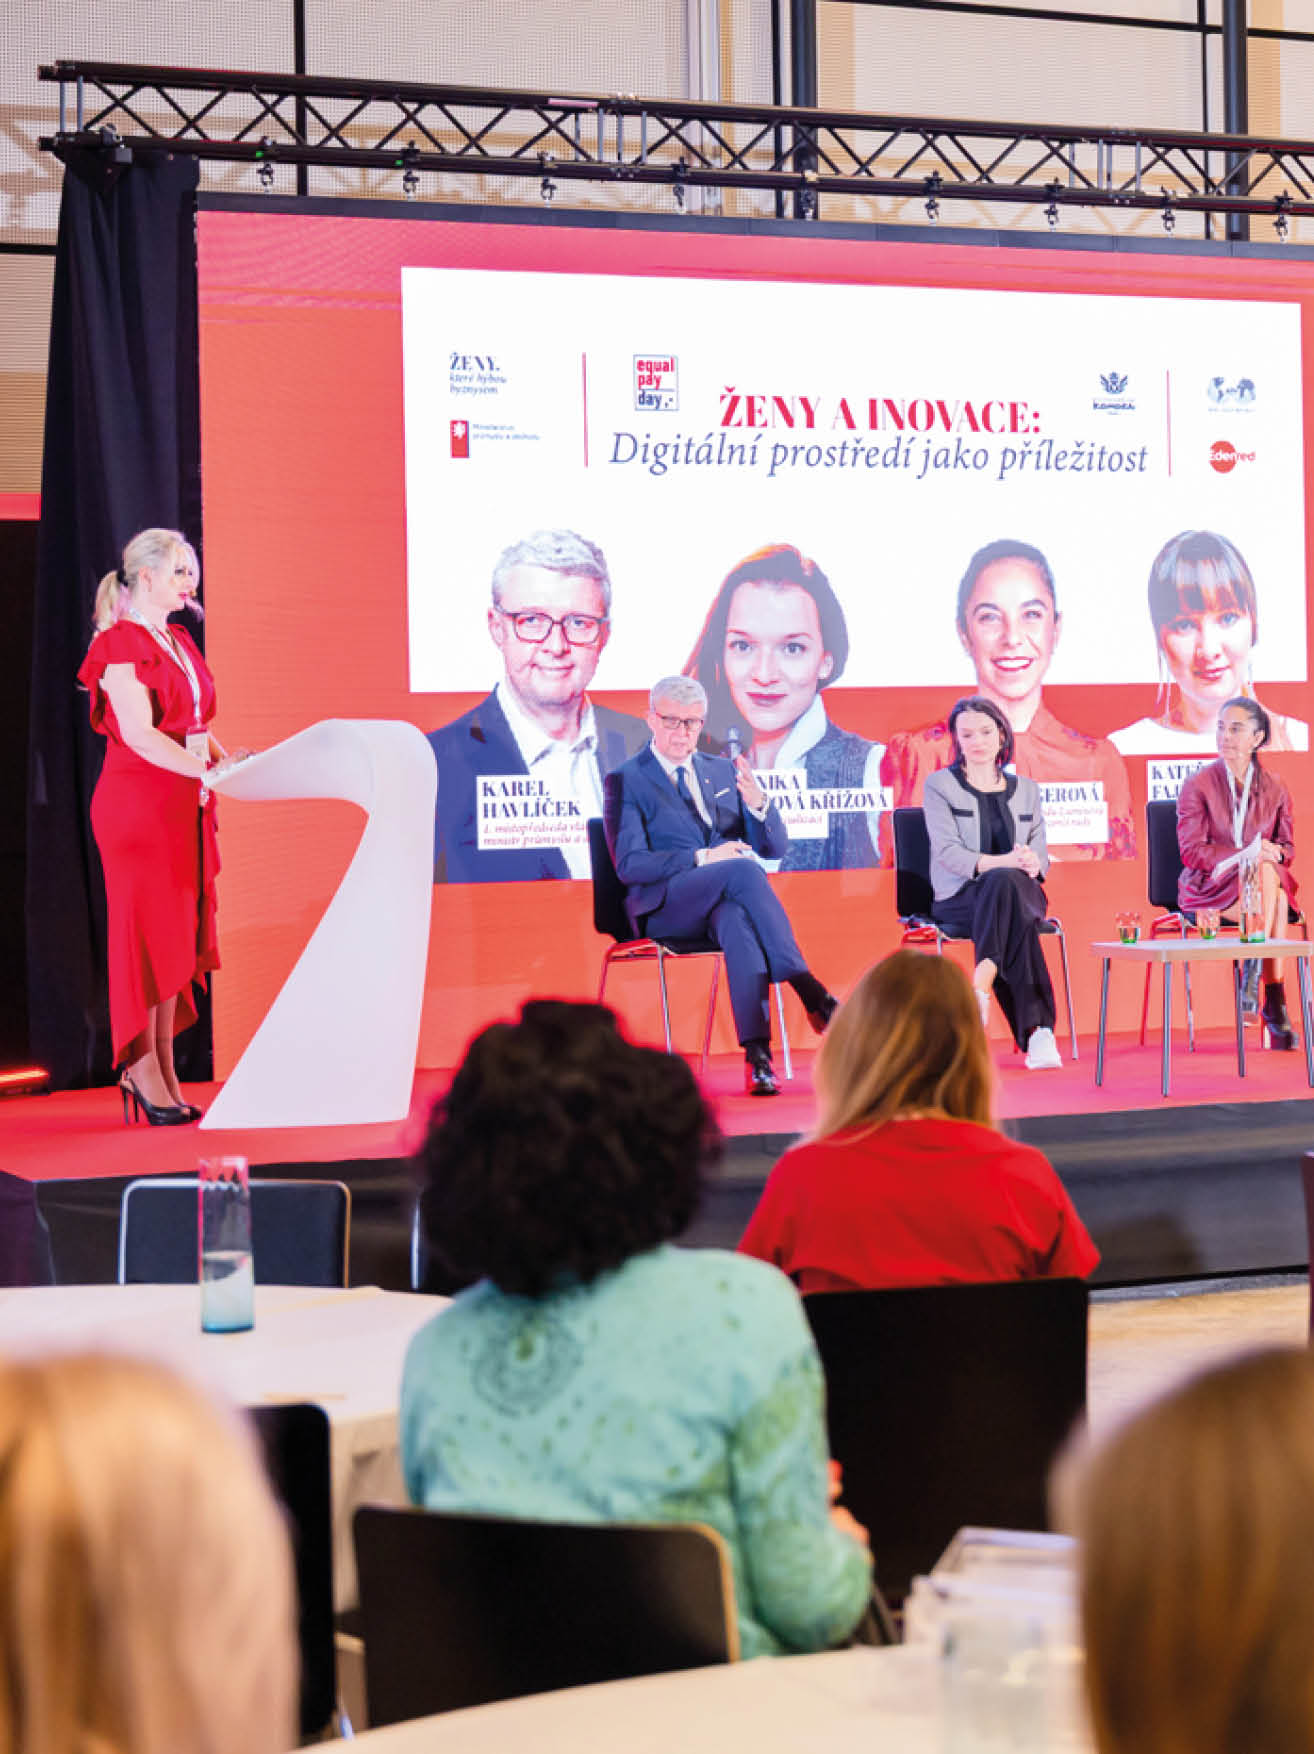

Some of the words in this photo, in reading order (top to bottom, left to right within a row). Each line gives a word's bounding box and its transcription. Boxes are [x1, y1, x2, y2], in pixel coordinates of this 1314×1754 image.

[637, 356, 675, 376] equal
[638, 375, 662, 391] pay
[720, 385, 821, 429] ŽENY
[831, 397, 857, 431] A
[868, 396, 1041, 434] INOVACE:
[608, 432, 763, 476] Digitální
[766, 435, 916, 478] prostředí
[916, 437, 989, 480] jako
[996, 438, 1149, 481] příležitost
[482, 780, 551, 797] KAREL
[756, 774, 801, 791] NIKA
[482, 797, 581, 819] HAVLÍČEK
[809, 790, 888, 811] KŘÍŽOVÁ
